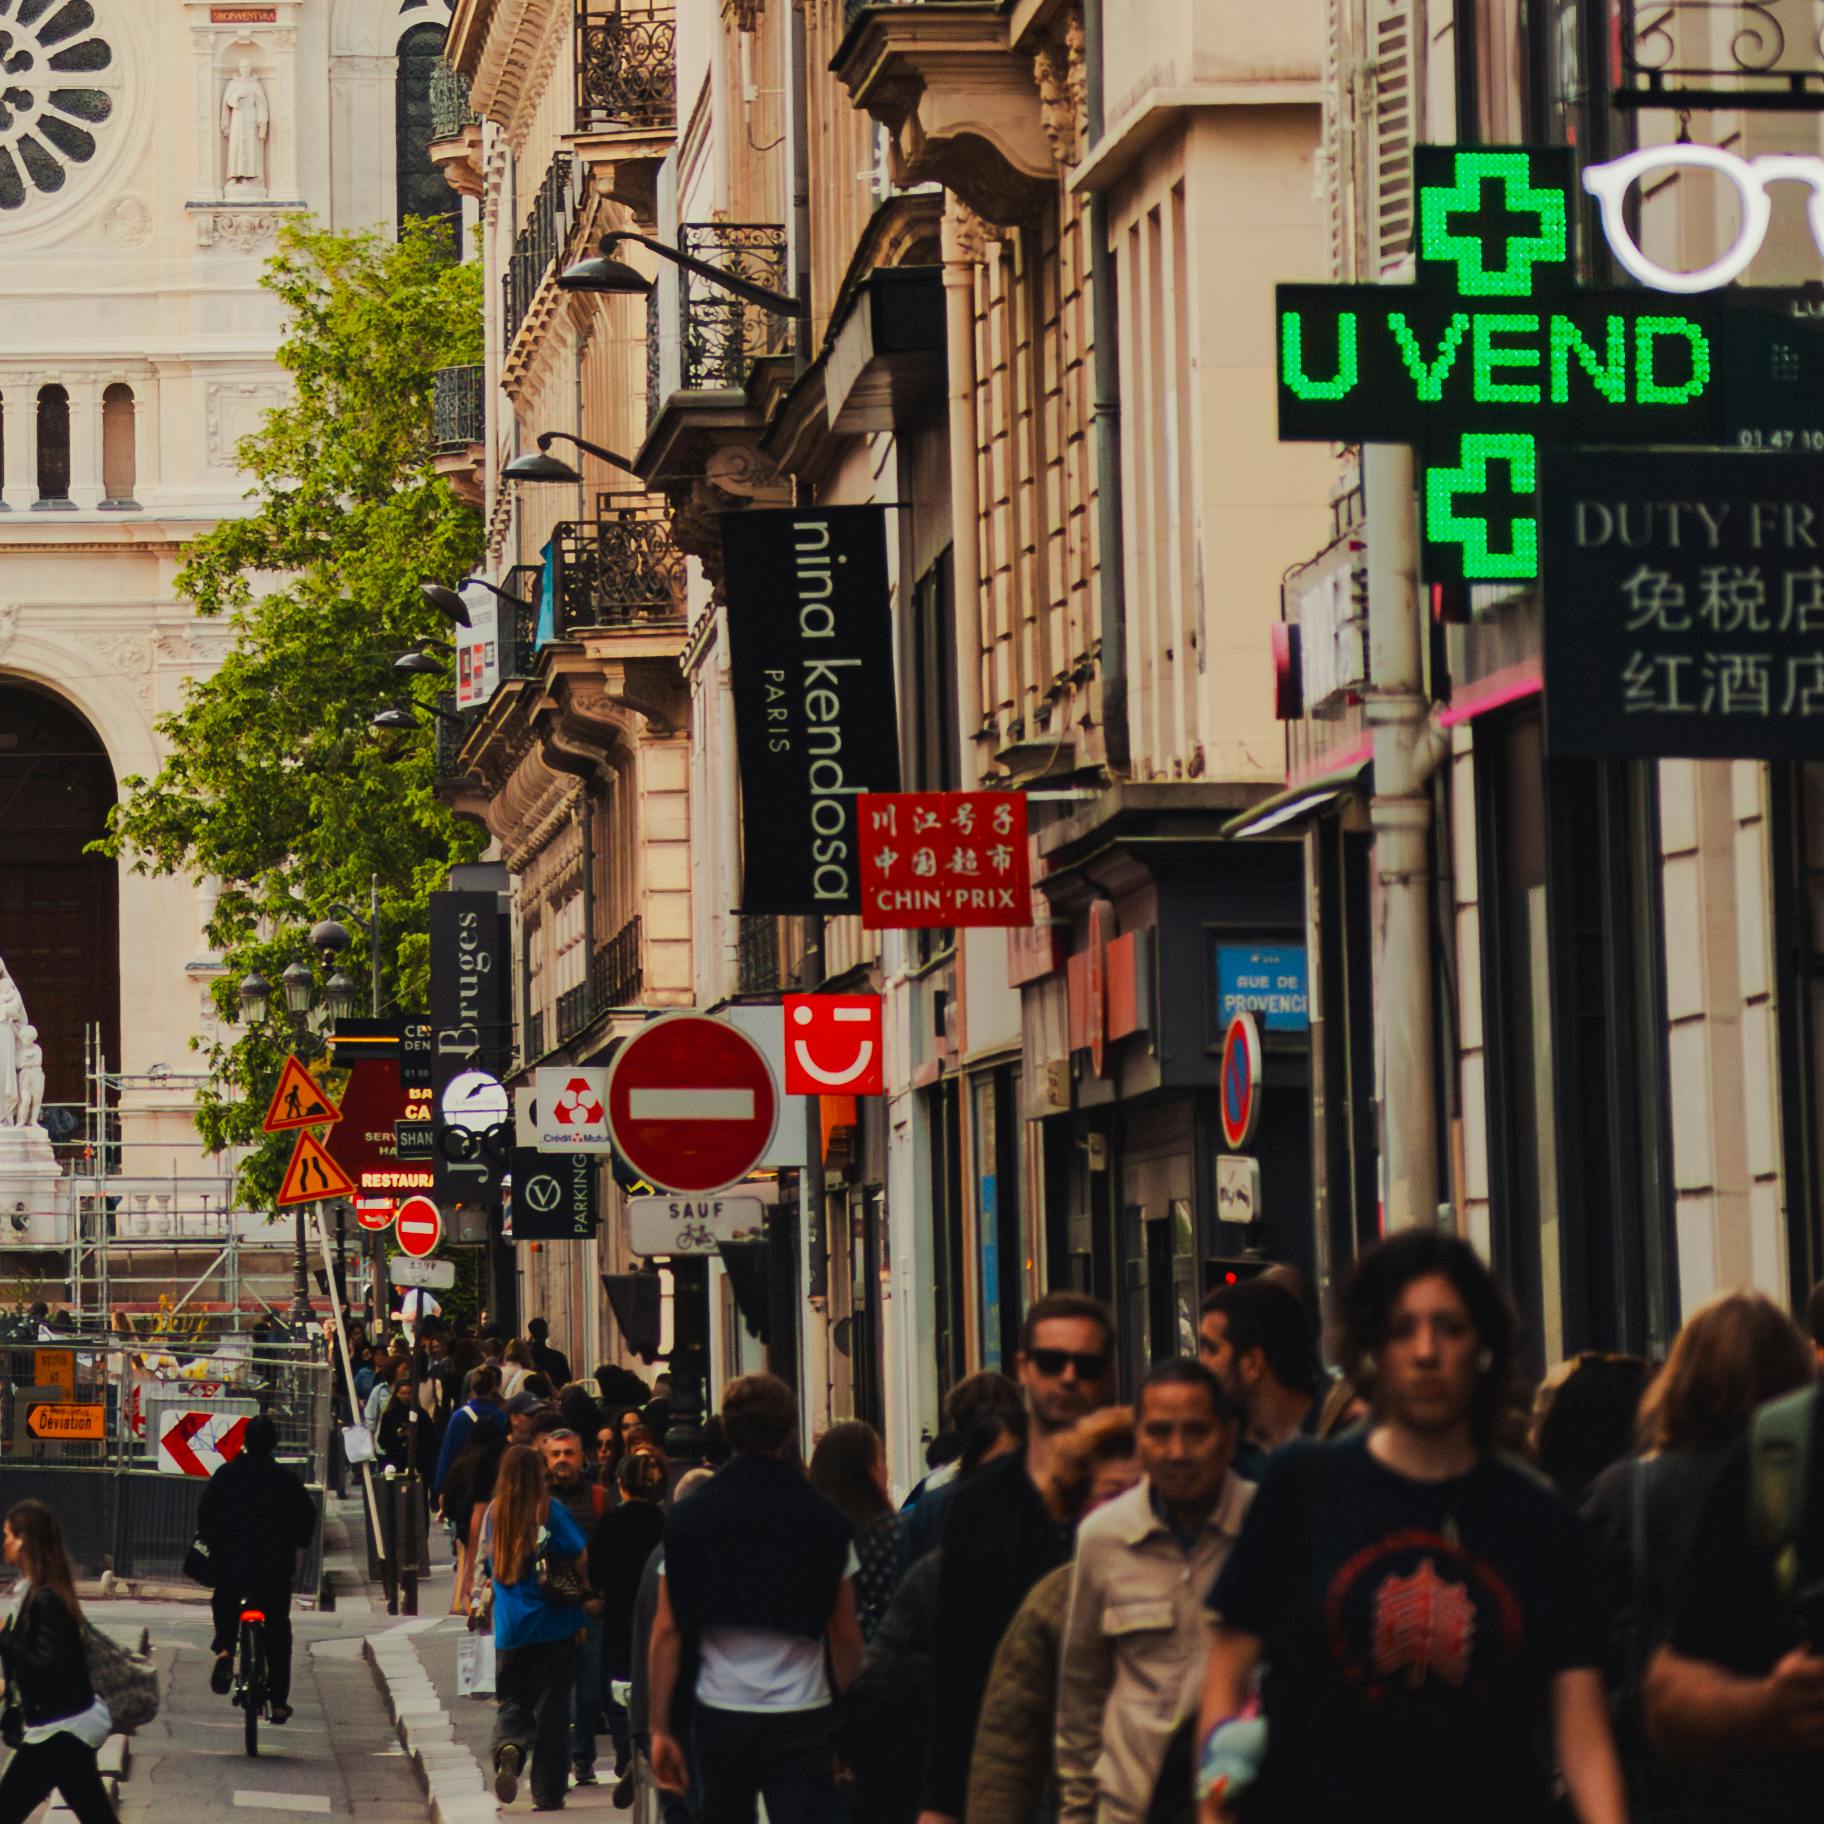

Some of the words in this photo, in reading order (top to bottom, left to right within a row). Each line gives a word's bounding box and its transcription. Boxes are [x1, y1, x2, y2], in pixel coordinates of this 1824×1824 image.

[1792, 300, 1824, 318] LU
[1281, 312, 1358, 401] U
[1387, 313, 1712, 404] VEND
[1574, 500, 1731, 549] DUTY
[794, 521, 847, 639] nina
[763, 669, 791, 754] PARIS
[803, 656, 869, 901] kendosa
[873, 843, 1015, 879] 中国超市
[438, 912, 494, 1058] Bruges
[1236, 976, 1270, 989] RUE
[1277, 976, 1298, 989] DE
[572, 1150, 590, 1234] PARKING
[669, 1202, 725, 1220] SAUF
